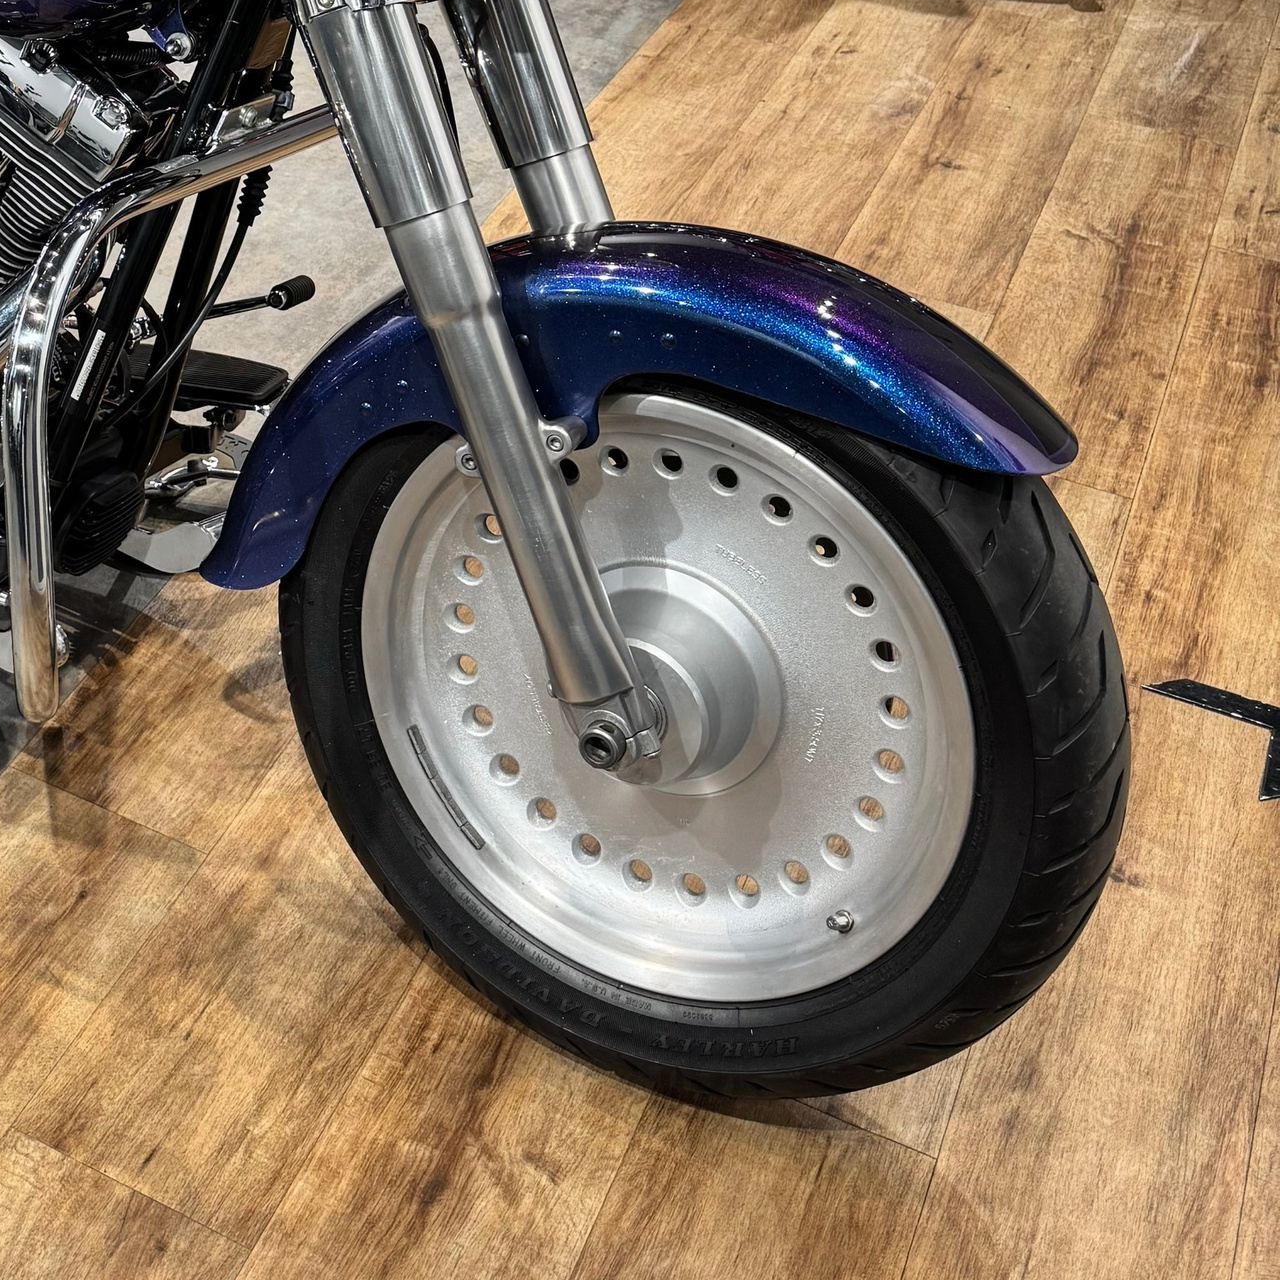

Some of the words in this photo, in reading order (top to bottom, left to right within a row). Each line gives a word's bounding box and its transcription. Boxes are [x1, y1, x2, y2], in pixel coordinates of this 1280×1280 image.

[716, 543, 768, 586] TUBELESS
[457, 892, 493, 926] FITMENT
[498, 924, 526, 952] WHEEL
[436, 907, 604, 1028] DAVIDSON
[529, 950, 561, 974] FRONT
[650, 1032, 799, 1058] HARLEY
